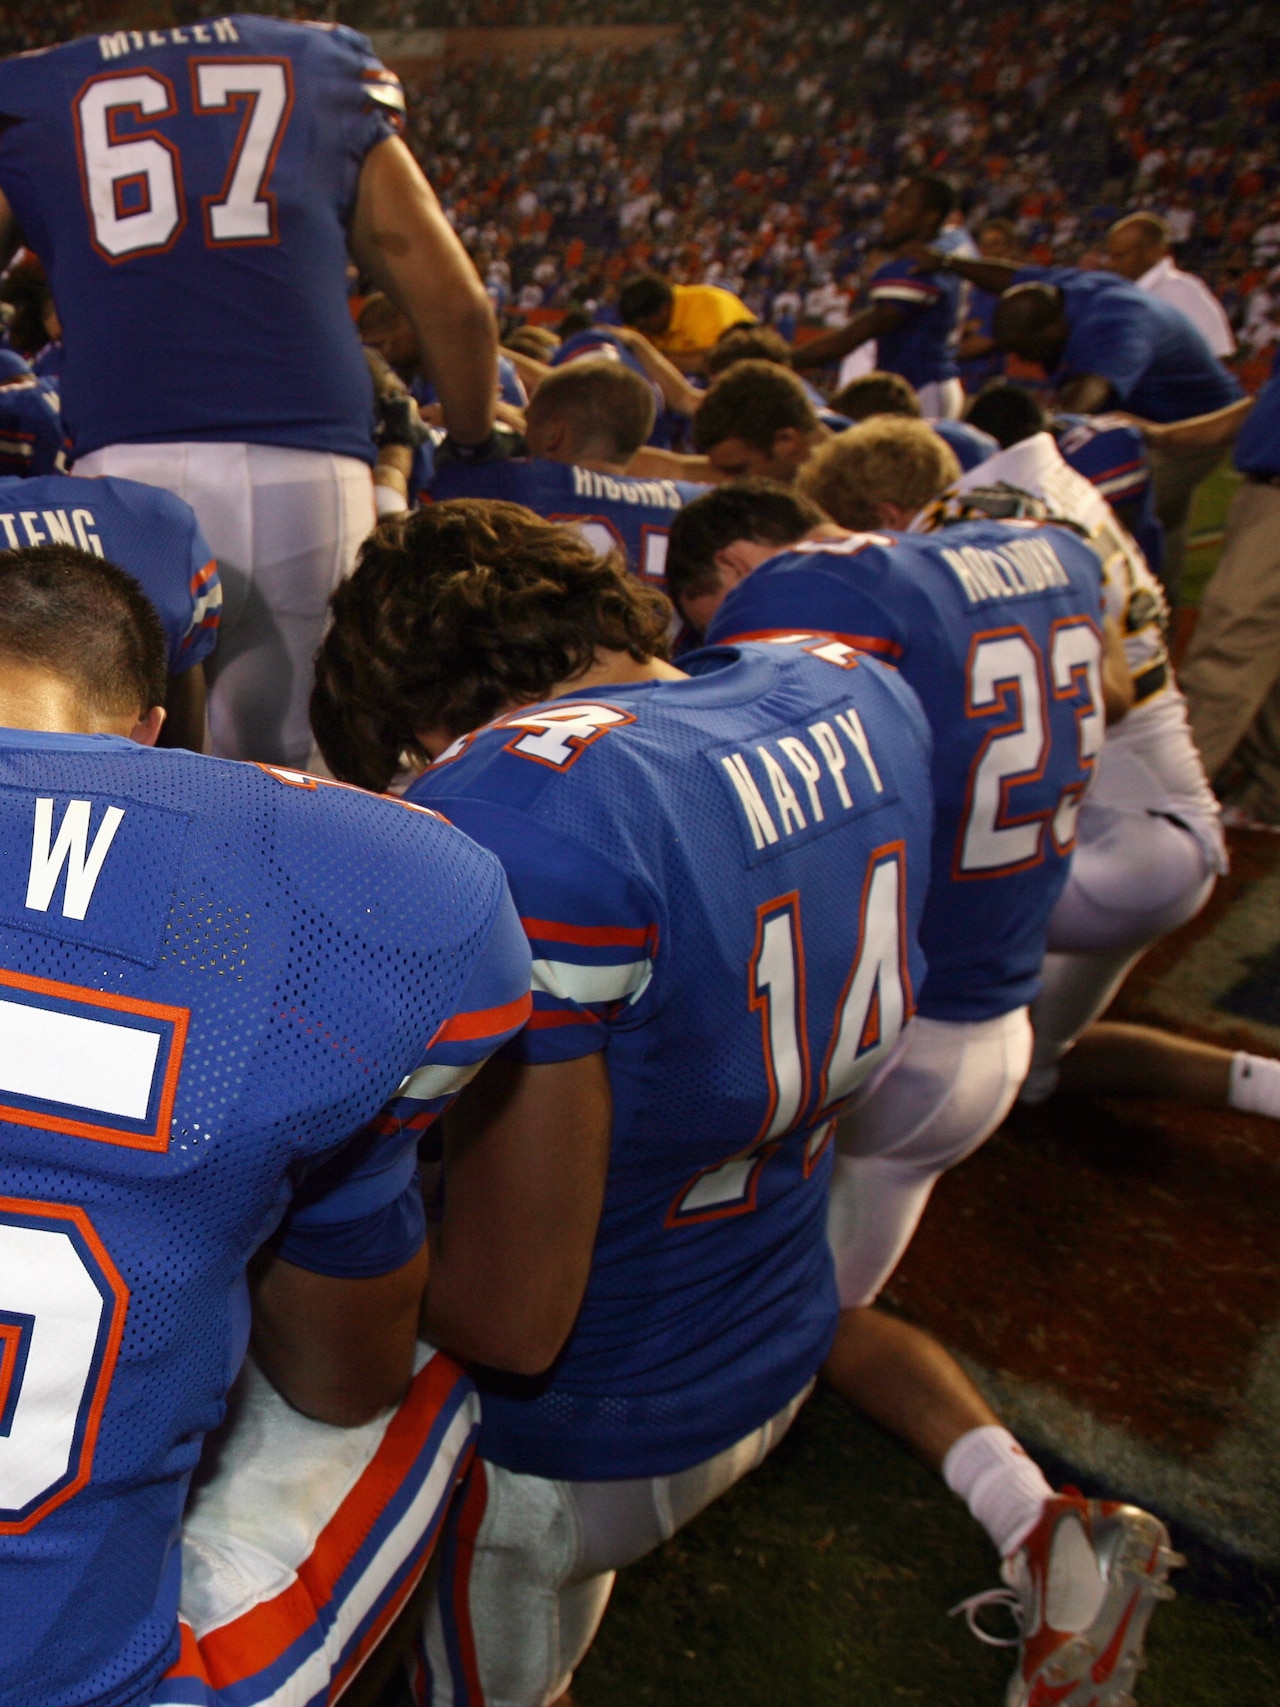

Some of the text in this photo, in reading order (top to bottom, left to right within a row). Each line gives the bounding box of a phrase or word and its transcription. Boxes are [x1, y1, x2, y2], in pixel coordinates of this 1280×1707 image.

[72, 56, 295, 265] 67
[721, 707, 884, 851] NAPPY
[952, 614, 1106, 882] 23
[664, 840, 915, 1229] 14
